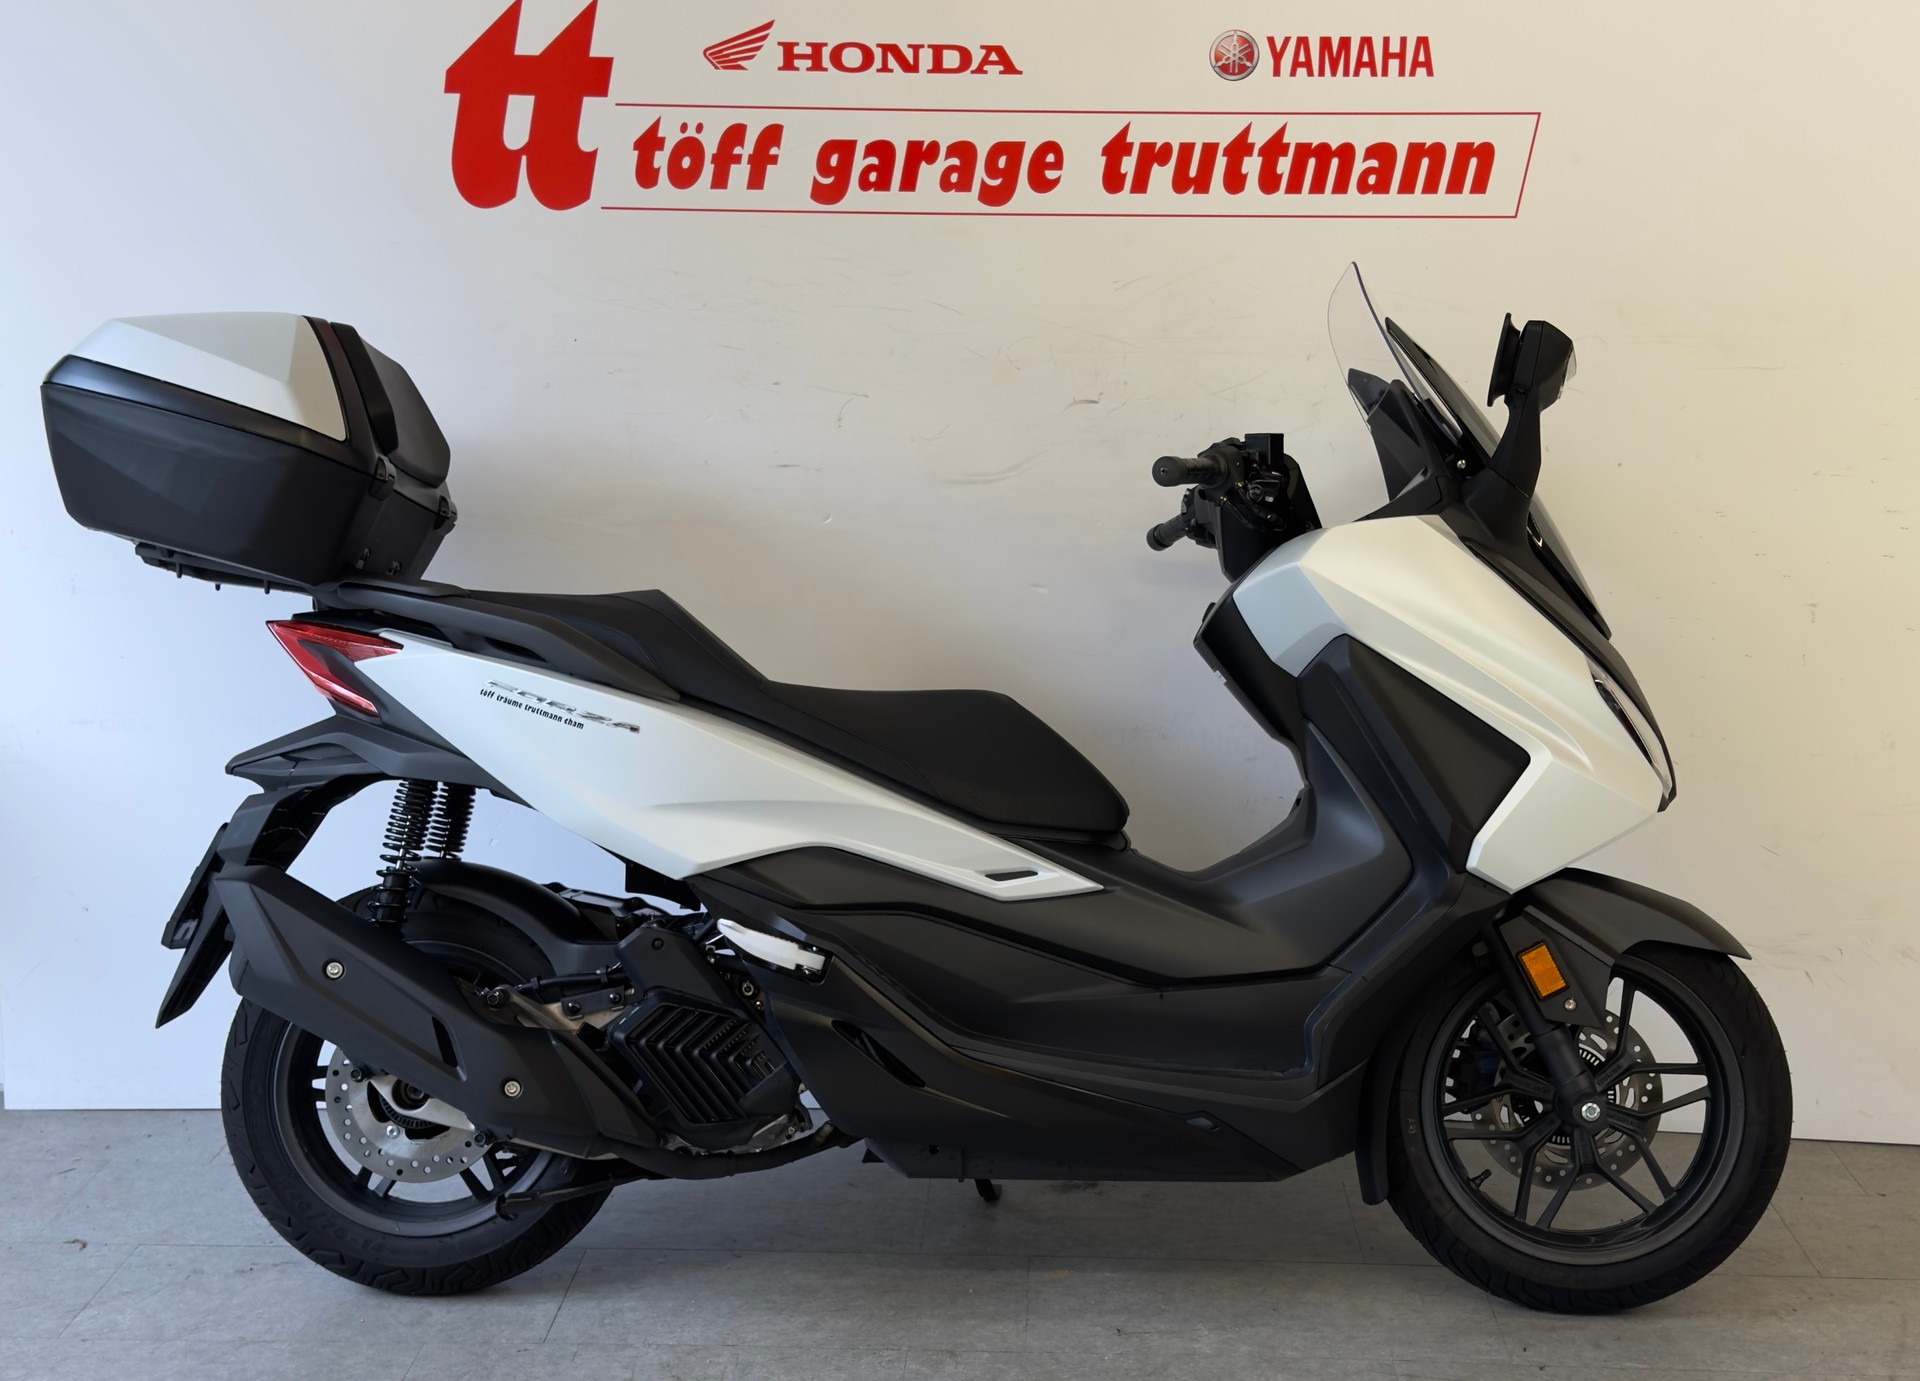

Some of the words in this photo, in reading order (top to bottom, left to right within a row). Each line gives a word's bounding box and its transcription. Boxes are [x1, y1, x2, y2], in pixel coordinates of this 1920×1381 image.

[777, 41, 1023, 76] HONDA
[1266, 36, 1434, 78] YAMAHA
[632, 117, 784, 191] töff
[810, 138, 1064, 206] garage
[1101, 122, 1496, 196] truttmann
[524, 703, 563, 723] truttmann
[564, 717, 585, 730] cham
